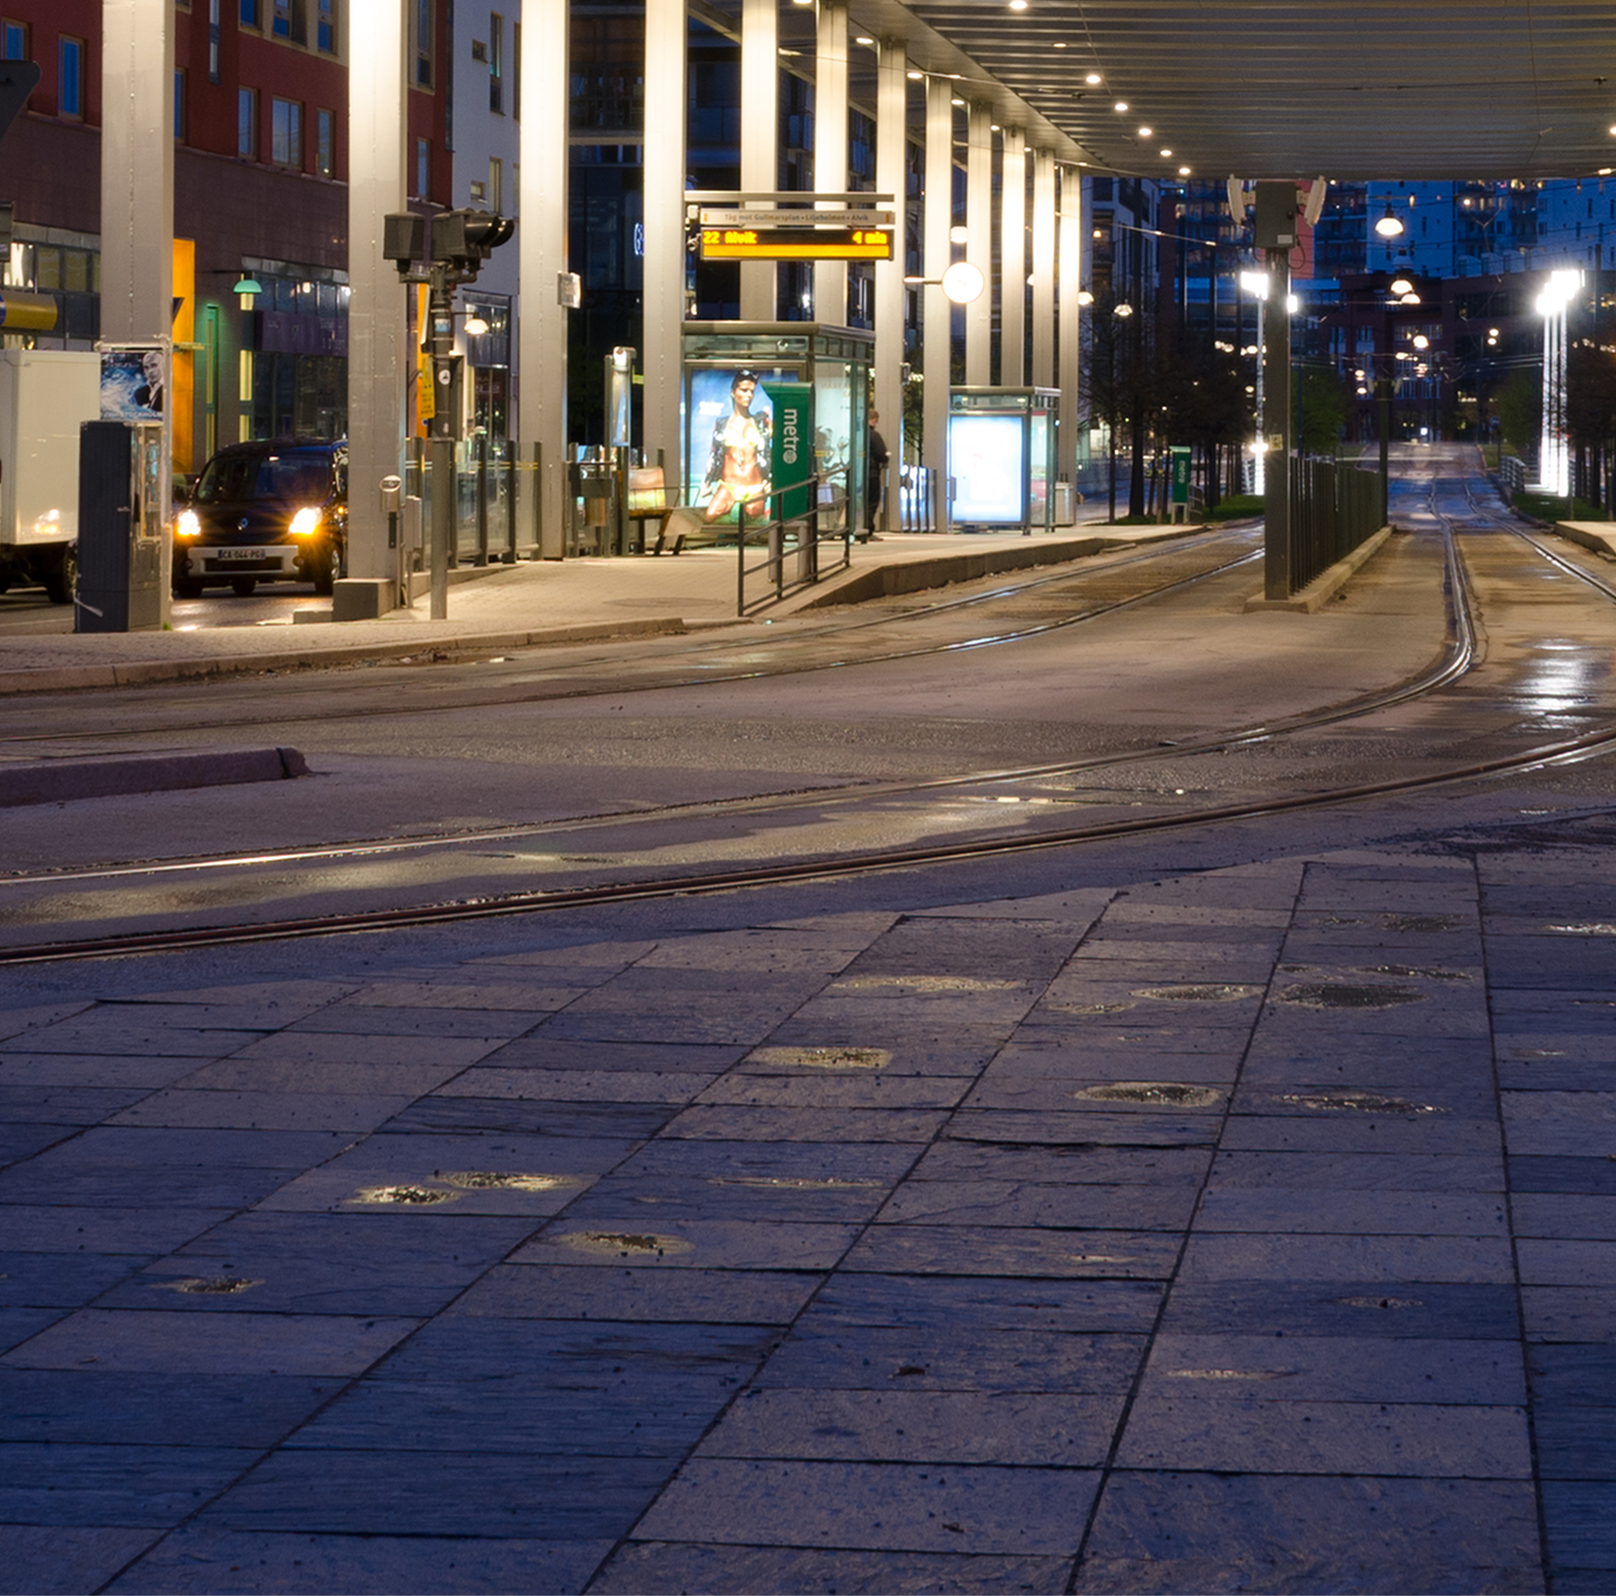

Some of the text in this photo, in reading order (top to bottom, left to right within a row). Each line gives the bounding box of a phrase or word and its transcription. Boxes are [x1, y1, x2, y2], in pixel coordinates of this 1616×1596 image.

[755, 213, 800, 223] Gullmarsplan
[851, 213, 869, 221] Alvik
[702, 231, 720, 244] 22
[852, 231, 862, 244] 4
[783, 408, 800, 464] metro
